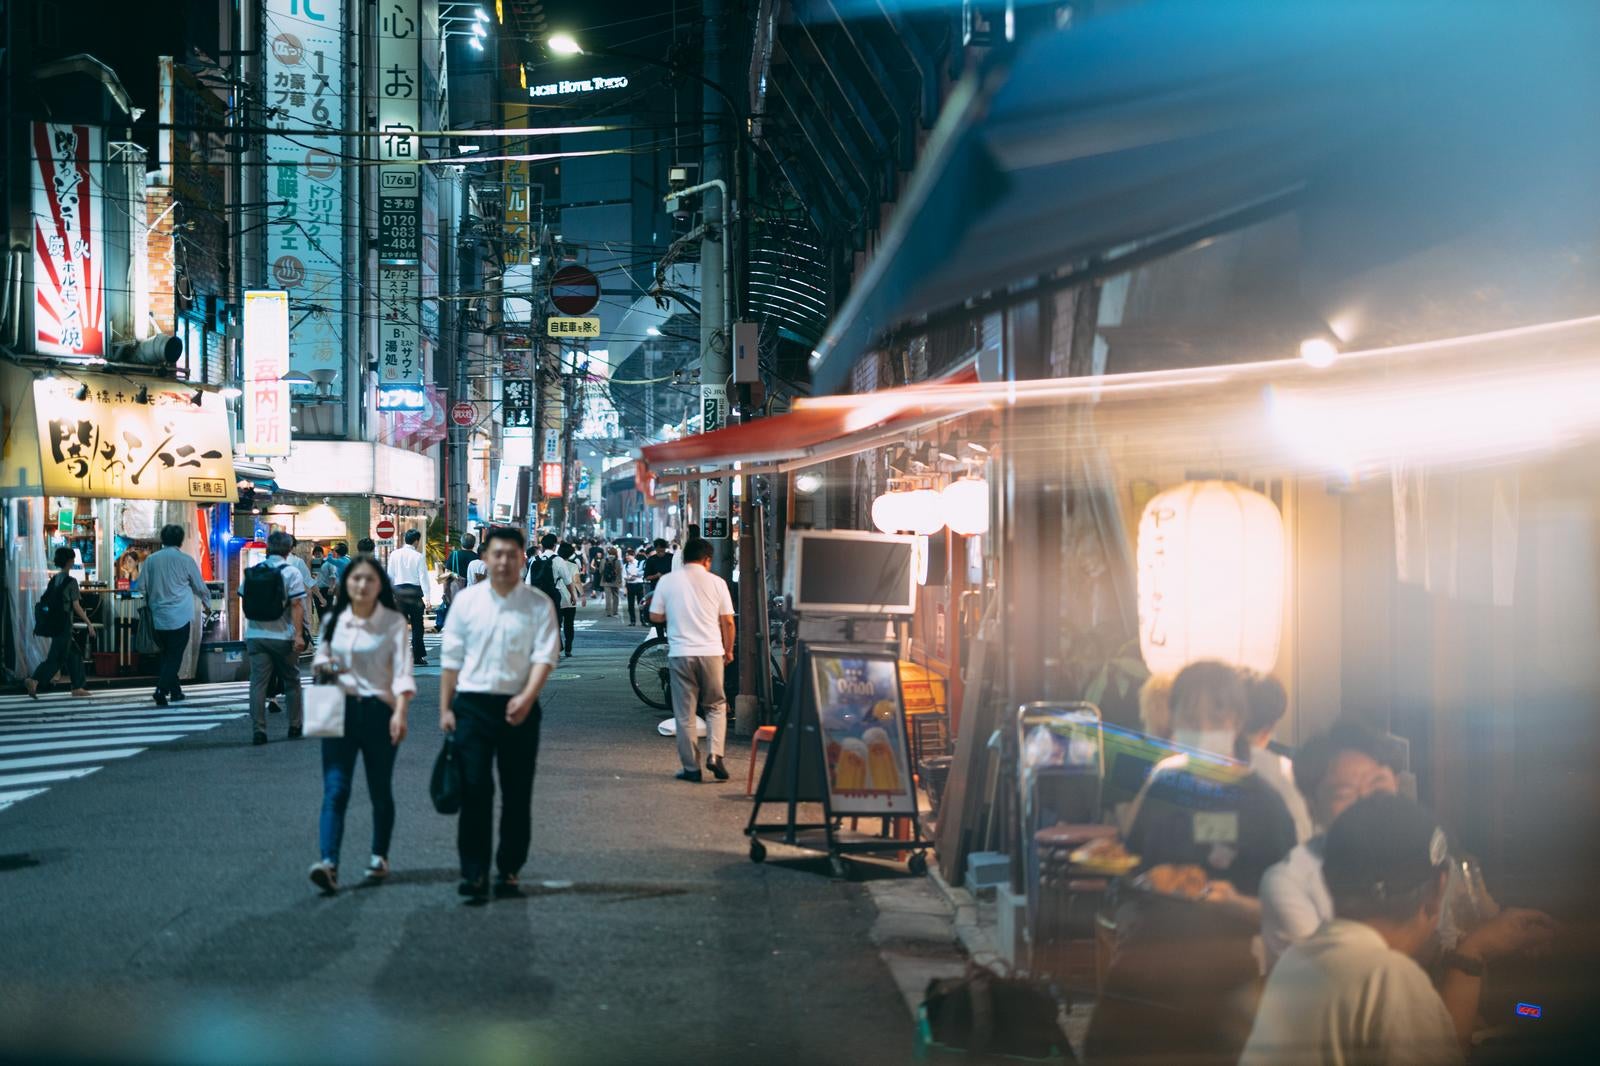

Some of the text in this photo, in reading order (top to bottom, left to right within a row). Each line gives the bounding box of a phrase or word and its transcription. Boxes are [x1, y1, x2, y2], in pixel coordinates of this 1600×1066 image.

[321, 187, 333, 226] フリー
[383, 199, 415, 209] ご予約
[382, 215, 416, 226] 0120
[383, 227, 416, 238] -083
[383, 238, 416, 249] -484
[550, 321, 598, 333] 自転車を除く
[385, 340, 398, 366] 湯処
[401, 347, 413, 379] サウナ
[705, 399, 715, 433] ウイン
[191, 481, 223, 494] 新橋店
